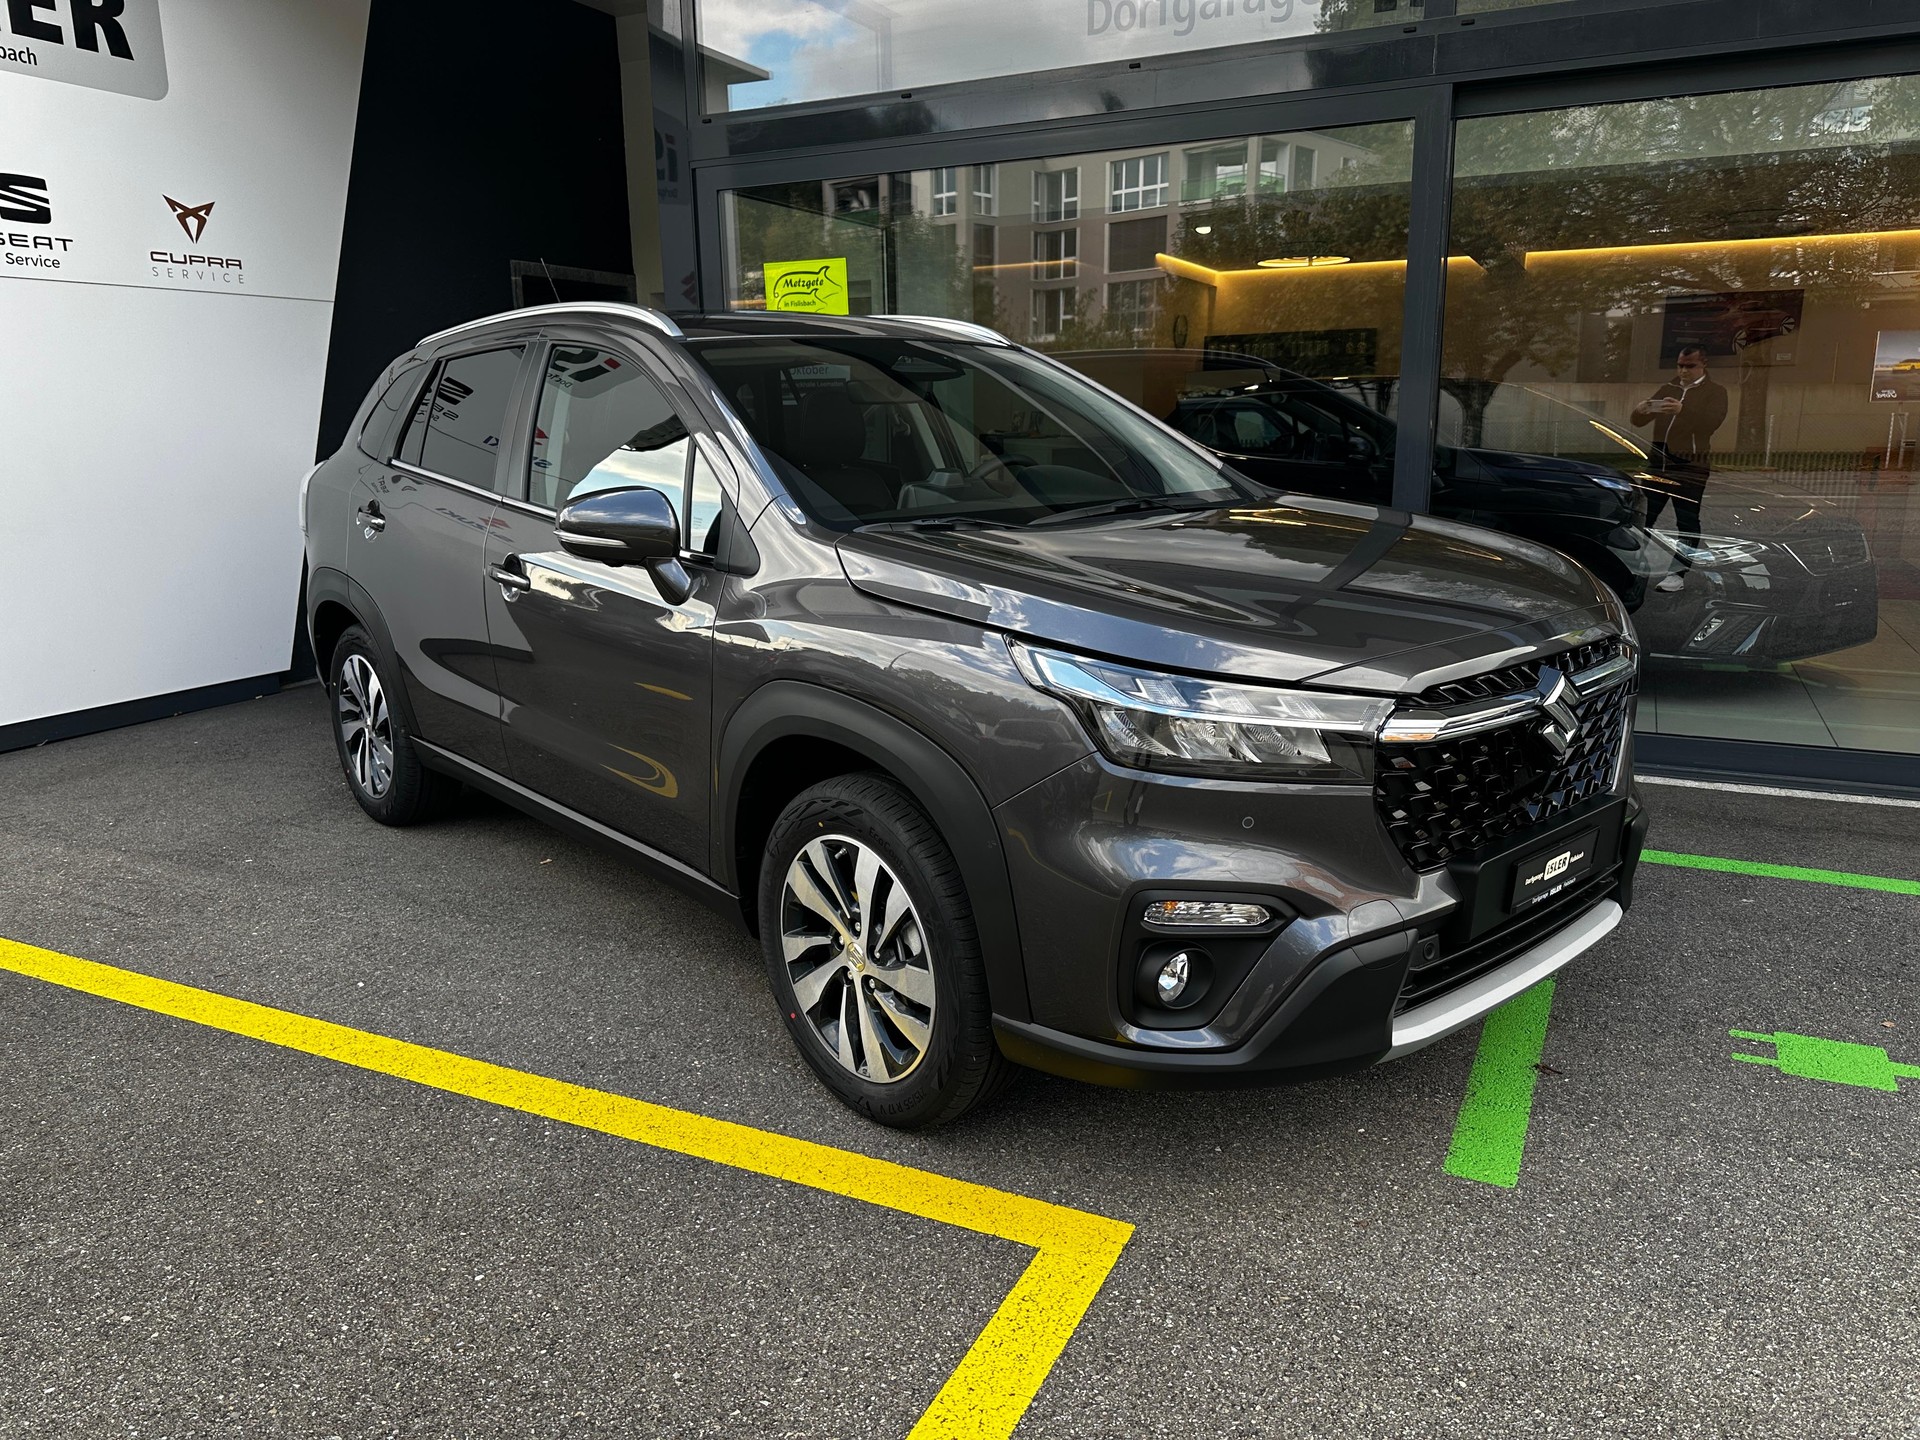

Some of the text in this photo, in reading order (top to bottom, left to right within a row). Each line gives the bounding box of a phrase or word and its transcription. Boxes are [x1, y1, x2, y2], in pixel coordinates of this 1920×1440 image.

[0, 0, 134, 61] ER
[0, 232, 73, 251] EAT
[5, 252, 60, 268] Service
[150, 251, 243, 270] CUPRA
[152, 266, 245, 284] SERVICE
[783, 278, 824, 289] Metzgete
